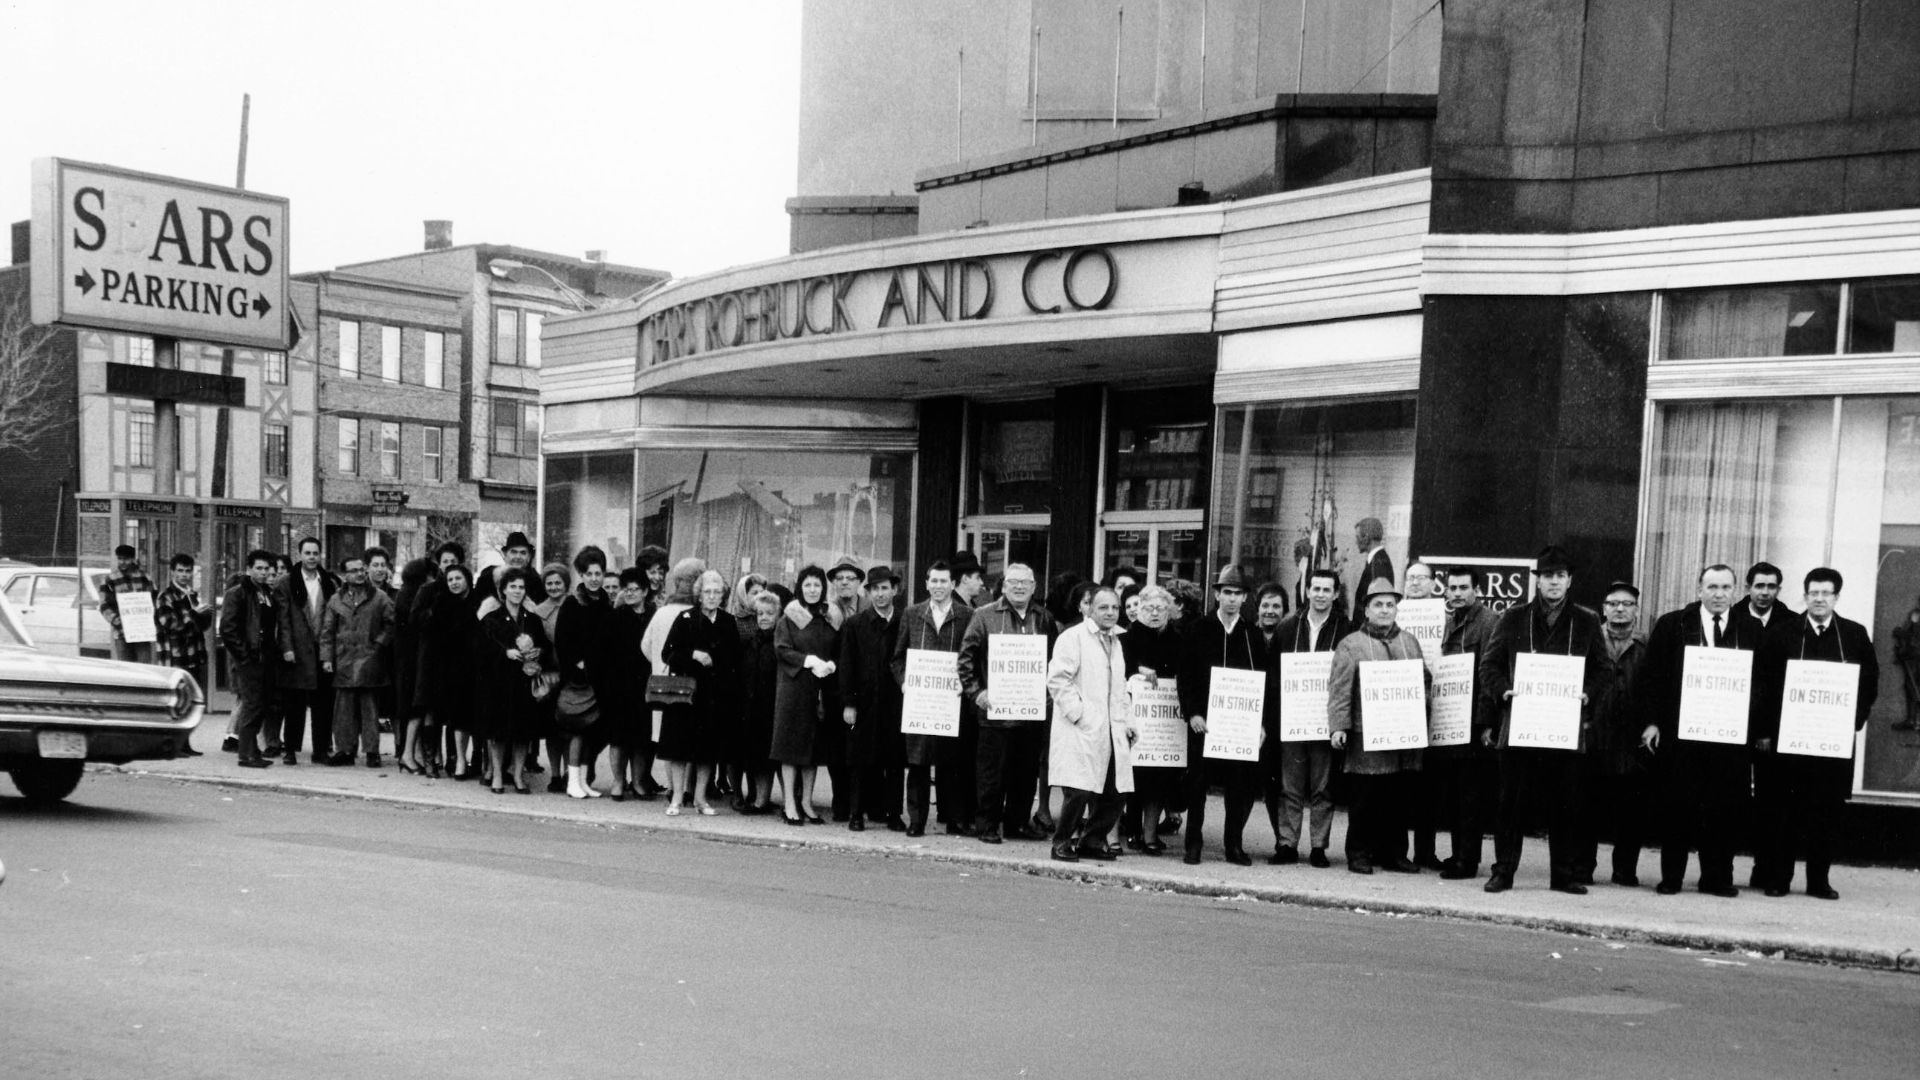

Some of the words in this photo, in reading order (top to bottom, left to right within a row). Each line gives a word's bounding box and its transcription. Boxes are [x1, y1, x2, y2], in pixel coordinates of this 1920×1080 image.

[73, 186, 273, 276] SARS
[101, 268, 249, 319] PARKING
[705, 272, 857, 352] ROEBUCK
[877, 259, 995, 328] AND
[1021, 245, 1119, 314] CO
[127, 500, 175, 513] TELEPHONE
[218, 504, 265, 518] TELEPHONE
[1431, 571, 1523, 598] SRS
[991, 660, 1005, 673] ON
[1008, 660, 1043, 674] STRIKE
[908, 674, 922, 688] ON
[924, 675, 960, 691] STRIKE
[1284, 679, 1299, 693] ON
[1302, 678, 1328, 692] STRI
[1432, 684, 1441, 698] ON
[1442, 680, 1470, 697] STRIKE
[1517, 681, 1533, 695] ON
[1536, 682, 1578, 699] STRIKE
[1686, 673, 1702, 688] ON
[1705, 675, 1746, 693] STRIKE
[1365, 687, 1379, 701] ON
[1382, 686, 1421, 701] STRIKE
[1789, 688, 1806, 703] ON
[1808, 689, 1849, 707] STRIKE
[1134, 704, 1148, 718] ON
[1211, 694, 1225, 709] ON
[1227, 695, 1261, 712] STRIKE
